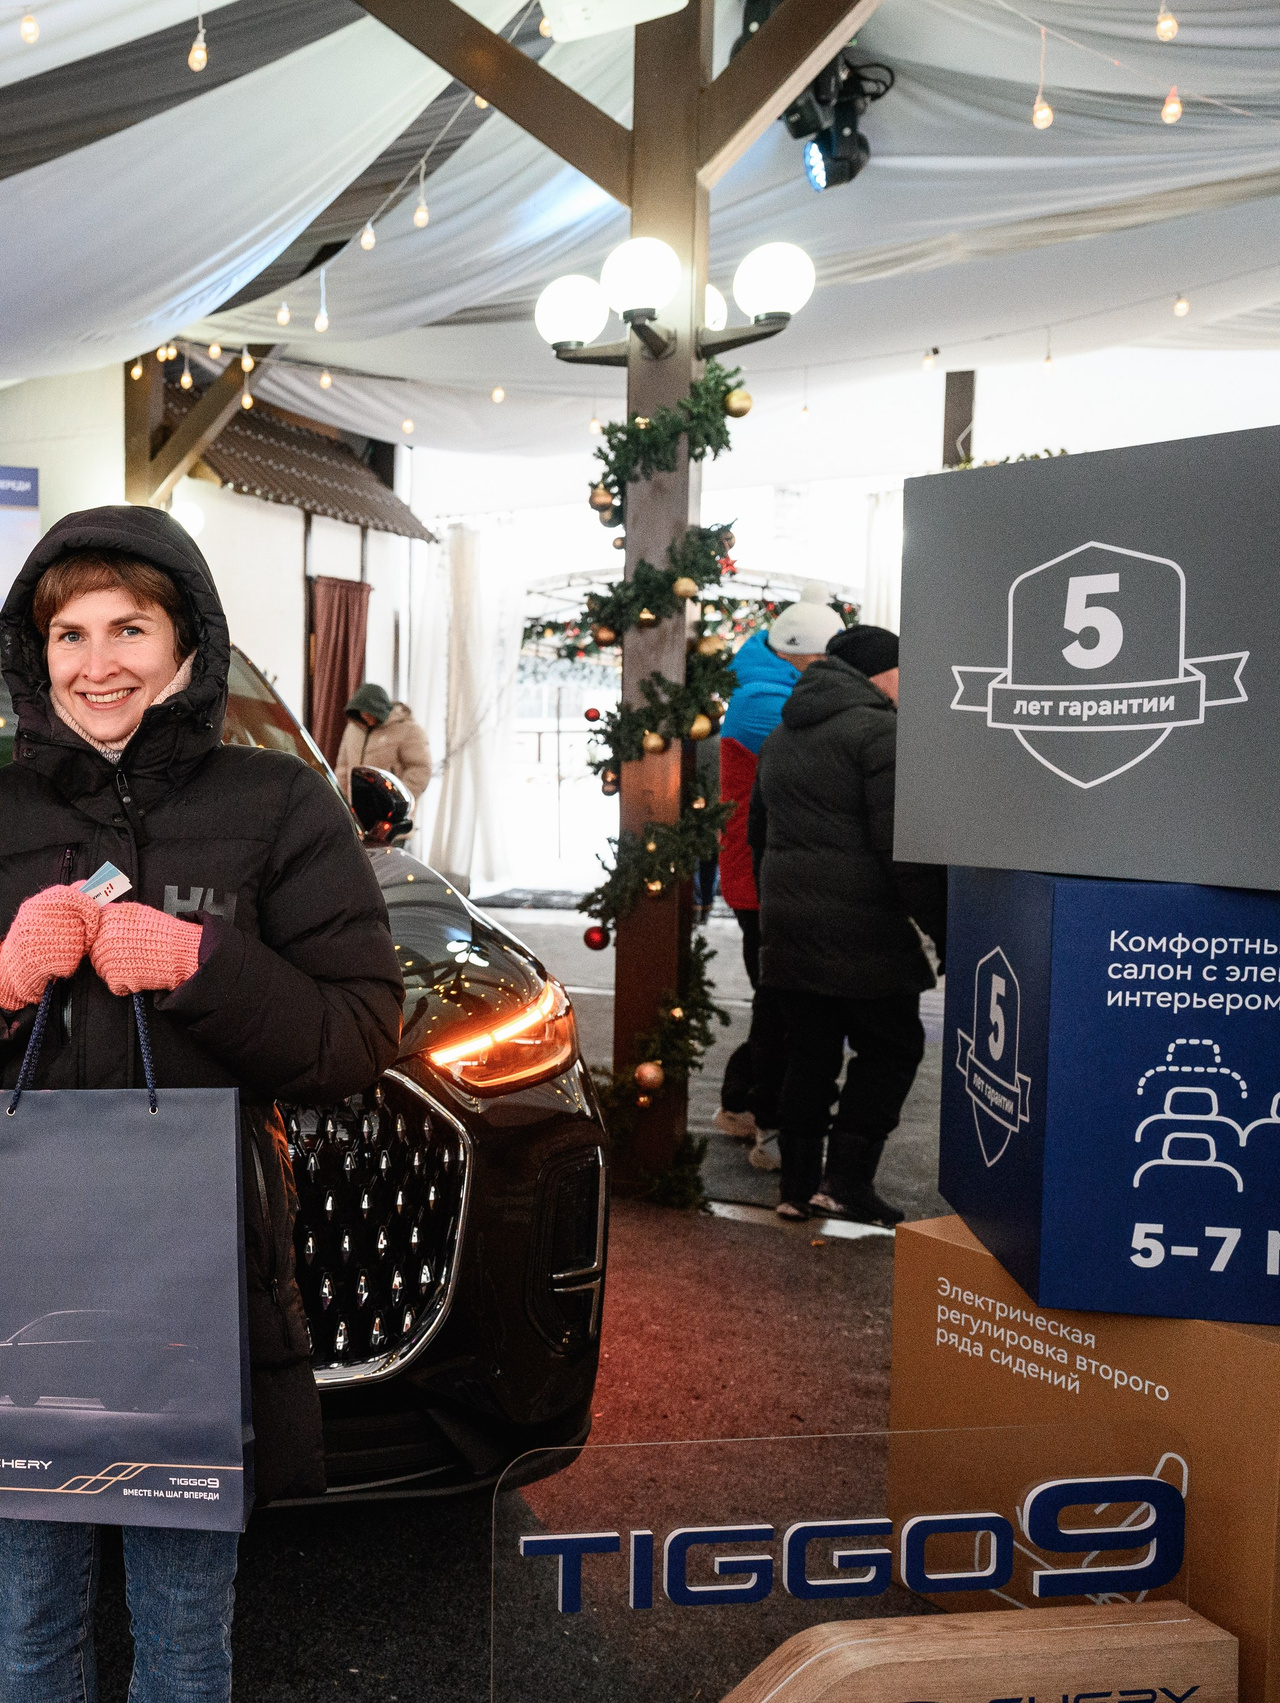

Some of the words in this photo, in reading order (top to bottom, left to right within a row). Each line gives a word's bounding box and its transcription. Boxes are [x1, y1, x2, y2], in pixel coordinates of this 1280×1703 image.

[1062, 572, 1124, 670] 5
[1013, 700, 1054, 715] лет
[1059, 695, 1175, 721] гарантии
[1107, 962, 1192, 981] салон
[1202, 964, 1218, 982] с
[1225, 965, 1280, 983] эле
[988, 973, 1006, 1062] 5
[1107, 990, 1280, 1016] интерьером
[973, 1072, 985, 1092] лет
[984, 1081, 1014, 1115] гарантии
[937, 1277, 1096, 1349] Электрическая
[936, 1327, 983, 1357] ряда
[990, 1347, 1080, 1395] сидений
[937, 1304, 1068, 1365] регулировка
[1076, 1355, 1170, 1401] второго
[123, 1488, 152, 1497] ВМЕСТЕ
[153, 1490, 164, 1498] НА
[165, 1490, 183, 1498] ШАГ
[184, 1491, 220, 1501] ВПЕРЕДИ
